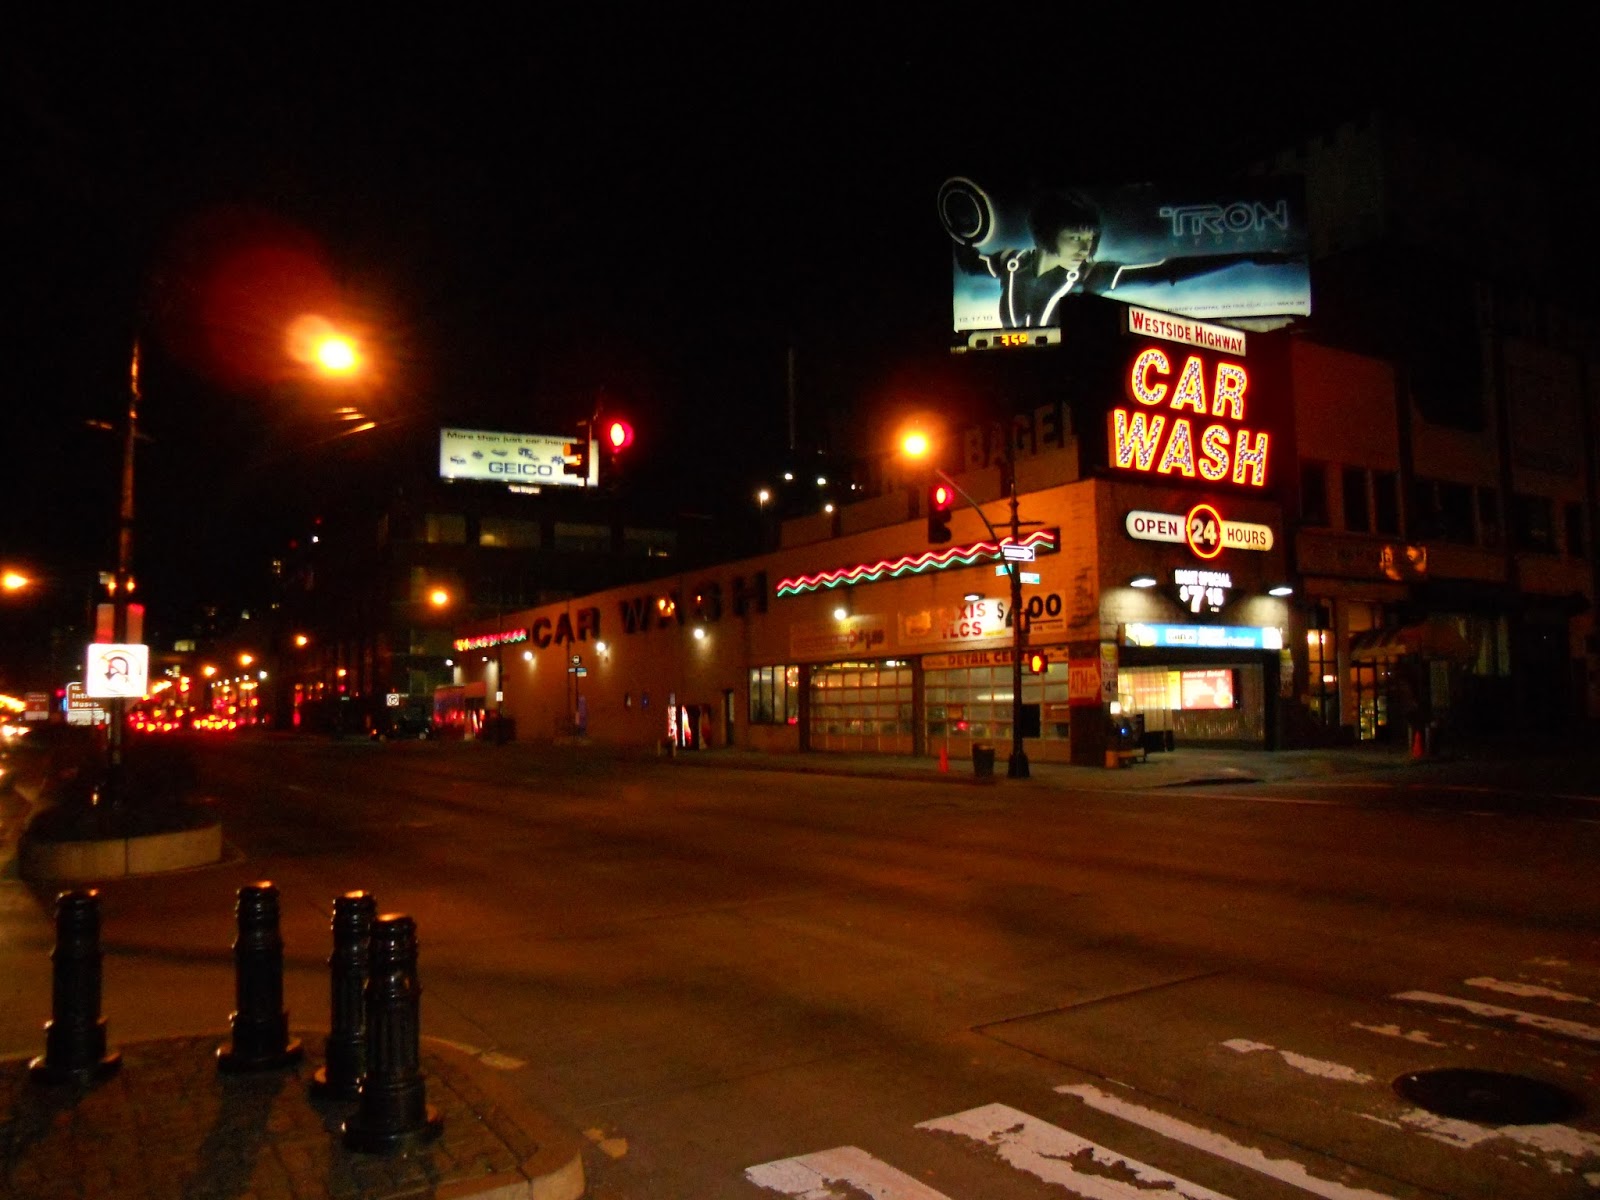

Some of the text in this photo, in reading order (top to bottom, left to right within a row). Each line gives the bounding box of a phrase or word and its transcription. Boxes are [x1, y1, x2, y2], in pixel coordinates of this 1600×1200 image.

[1158, 199, 1289, 236] TRON
[1130, 348, 1248, 421] CAR
[1113, 408, 1270, 487] WASH
[487, 461, 554, 477] GEICO
[1134, 517, 1268, 547] OPEN 24 HOURS
[531, 606, 602, 649] CAR
